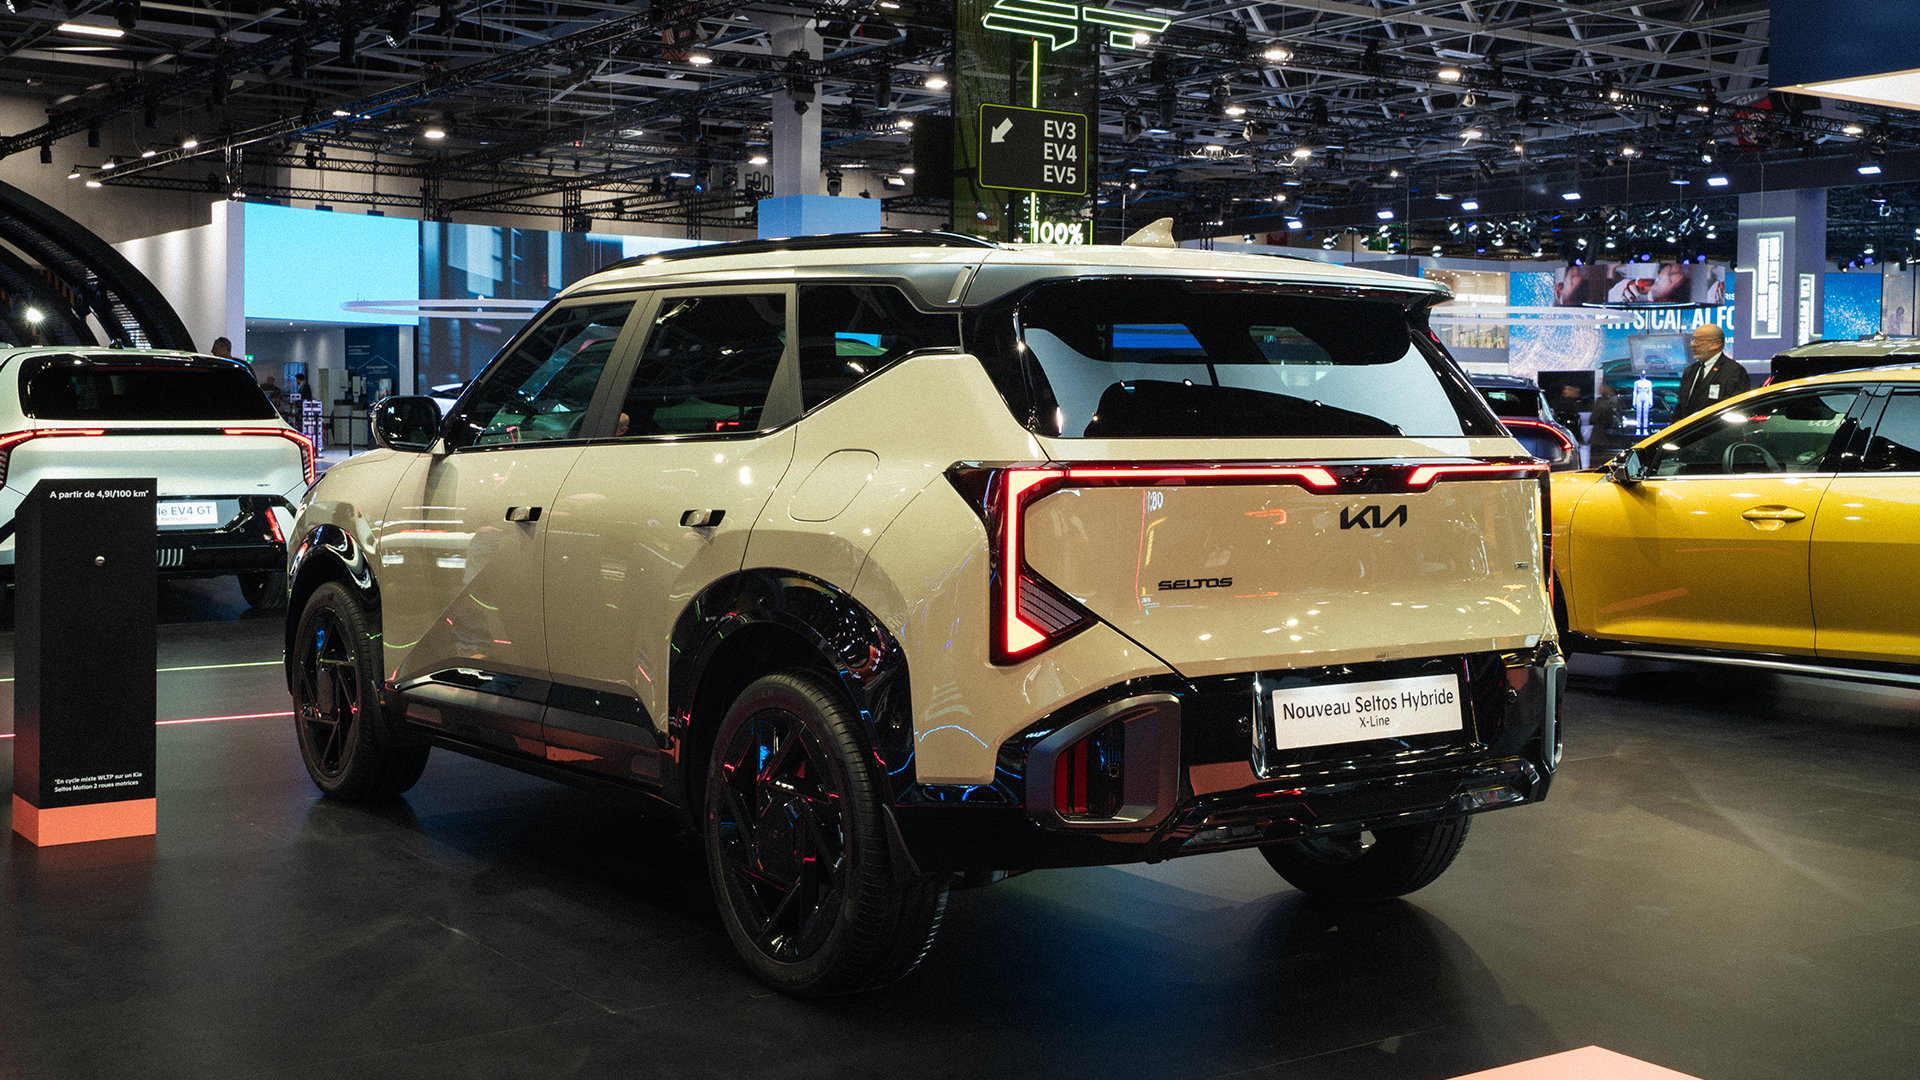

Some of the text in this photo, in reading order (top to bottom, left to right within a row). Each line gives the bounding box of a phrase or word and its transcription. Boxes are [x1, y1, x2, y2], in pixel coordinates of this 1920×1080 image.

[1043, 119, 1077, 140] EV3
[1043, 142, 1078, 162] EV4
[1043, 164, 1077, 184] EV5
[1031, 220, 1084, 246] 100%
[49, 490, 57, 499] A
[58, 490, 83, 501] partir
[84, 490, 95, 498] de
[171, 505, 193, 516] EV4
[196, 505, 212, 516] GT
[1340, 504, 1408, 530] KIA
[1158, 577, 1233, 591] SELTOS
[1282, 688, 1454, 721] Nouveau Seltos Hybride
[1359, 714, 1390, 729] X-Line
[54, 785, 72, 793] Seltos
[114, 780, 139, 788] motrices
[65, 777, 80, 785] cycle
[97, 773, 114, 781] WLTP
